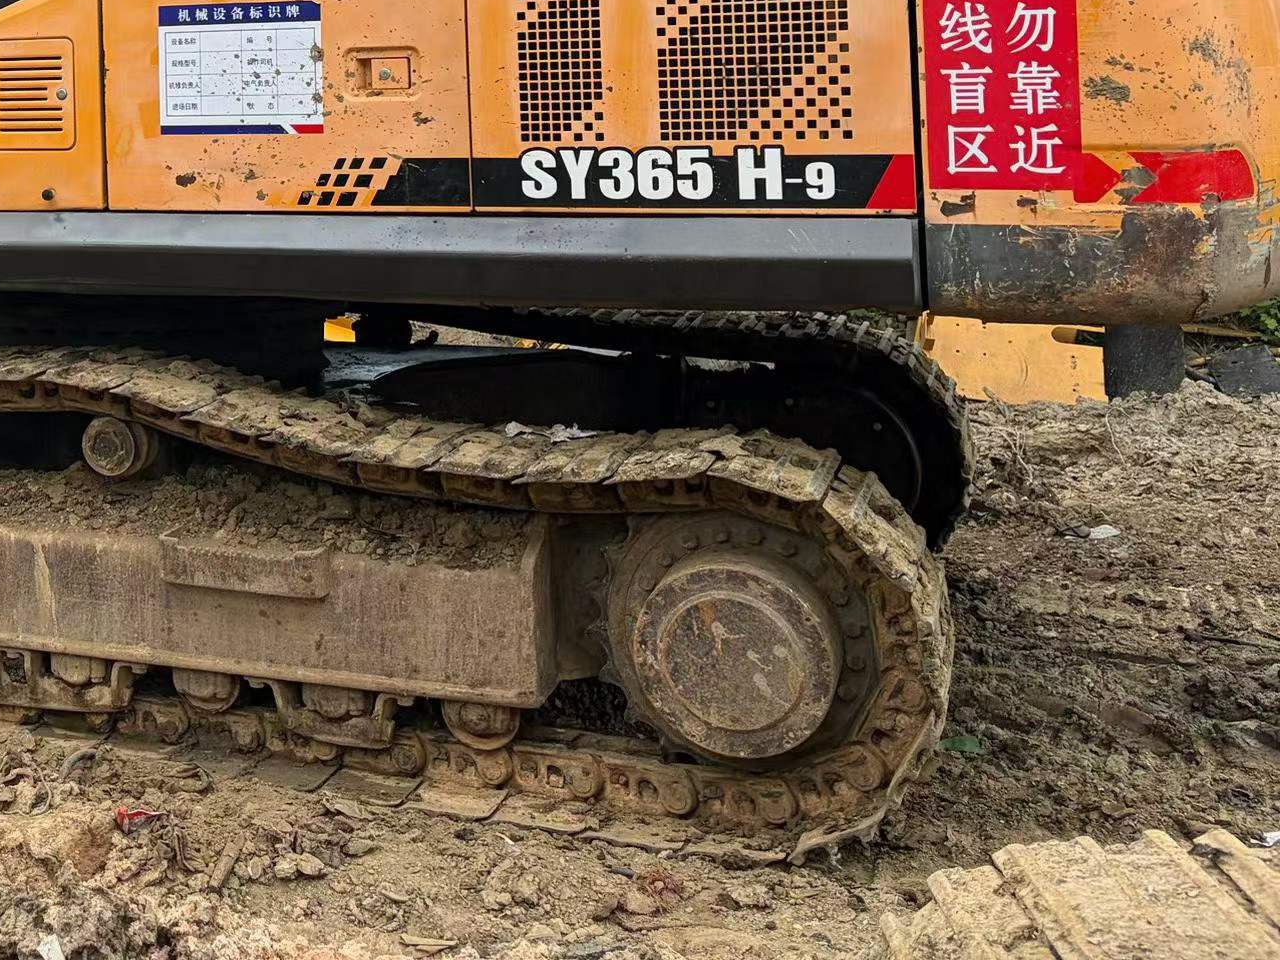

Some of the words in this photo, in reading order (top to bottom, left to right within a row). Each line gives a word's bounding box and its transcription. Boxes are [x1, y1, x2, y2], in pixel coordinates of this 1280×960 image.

[177, 4, 301, 22] 机械设备标识牌
[520, 147, 714, 201] SY365
